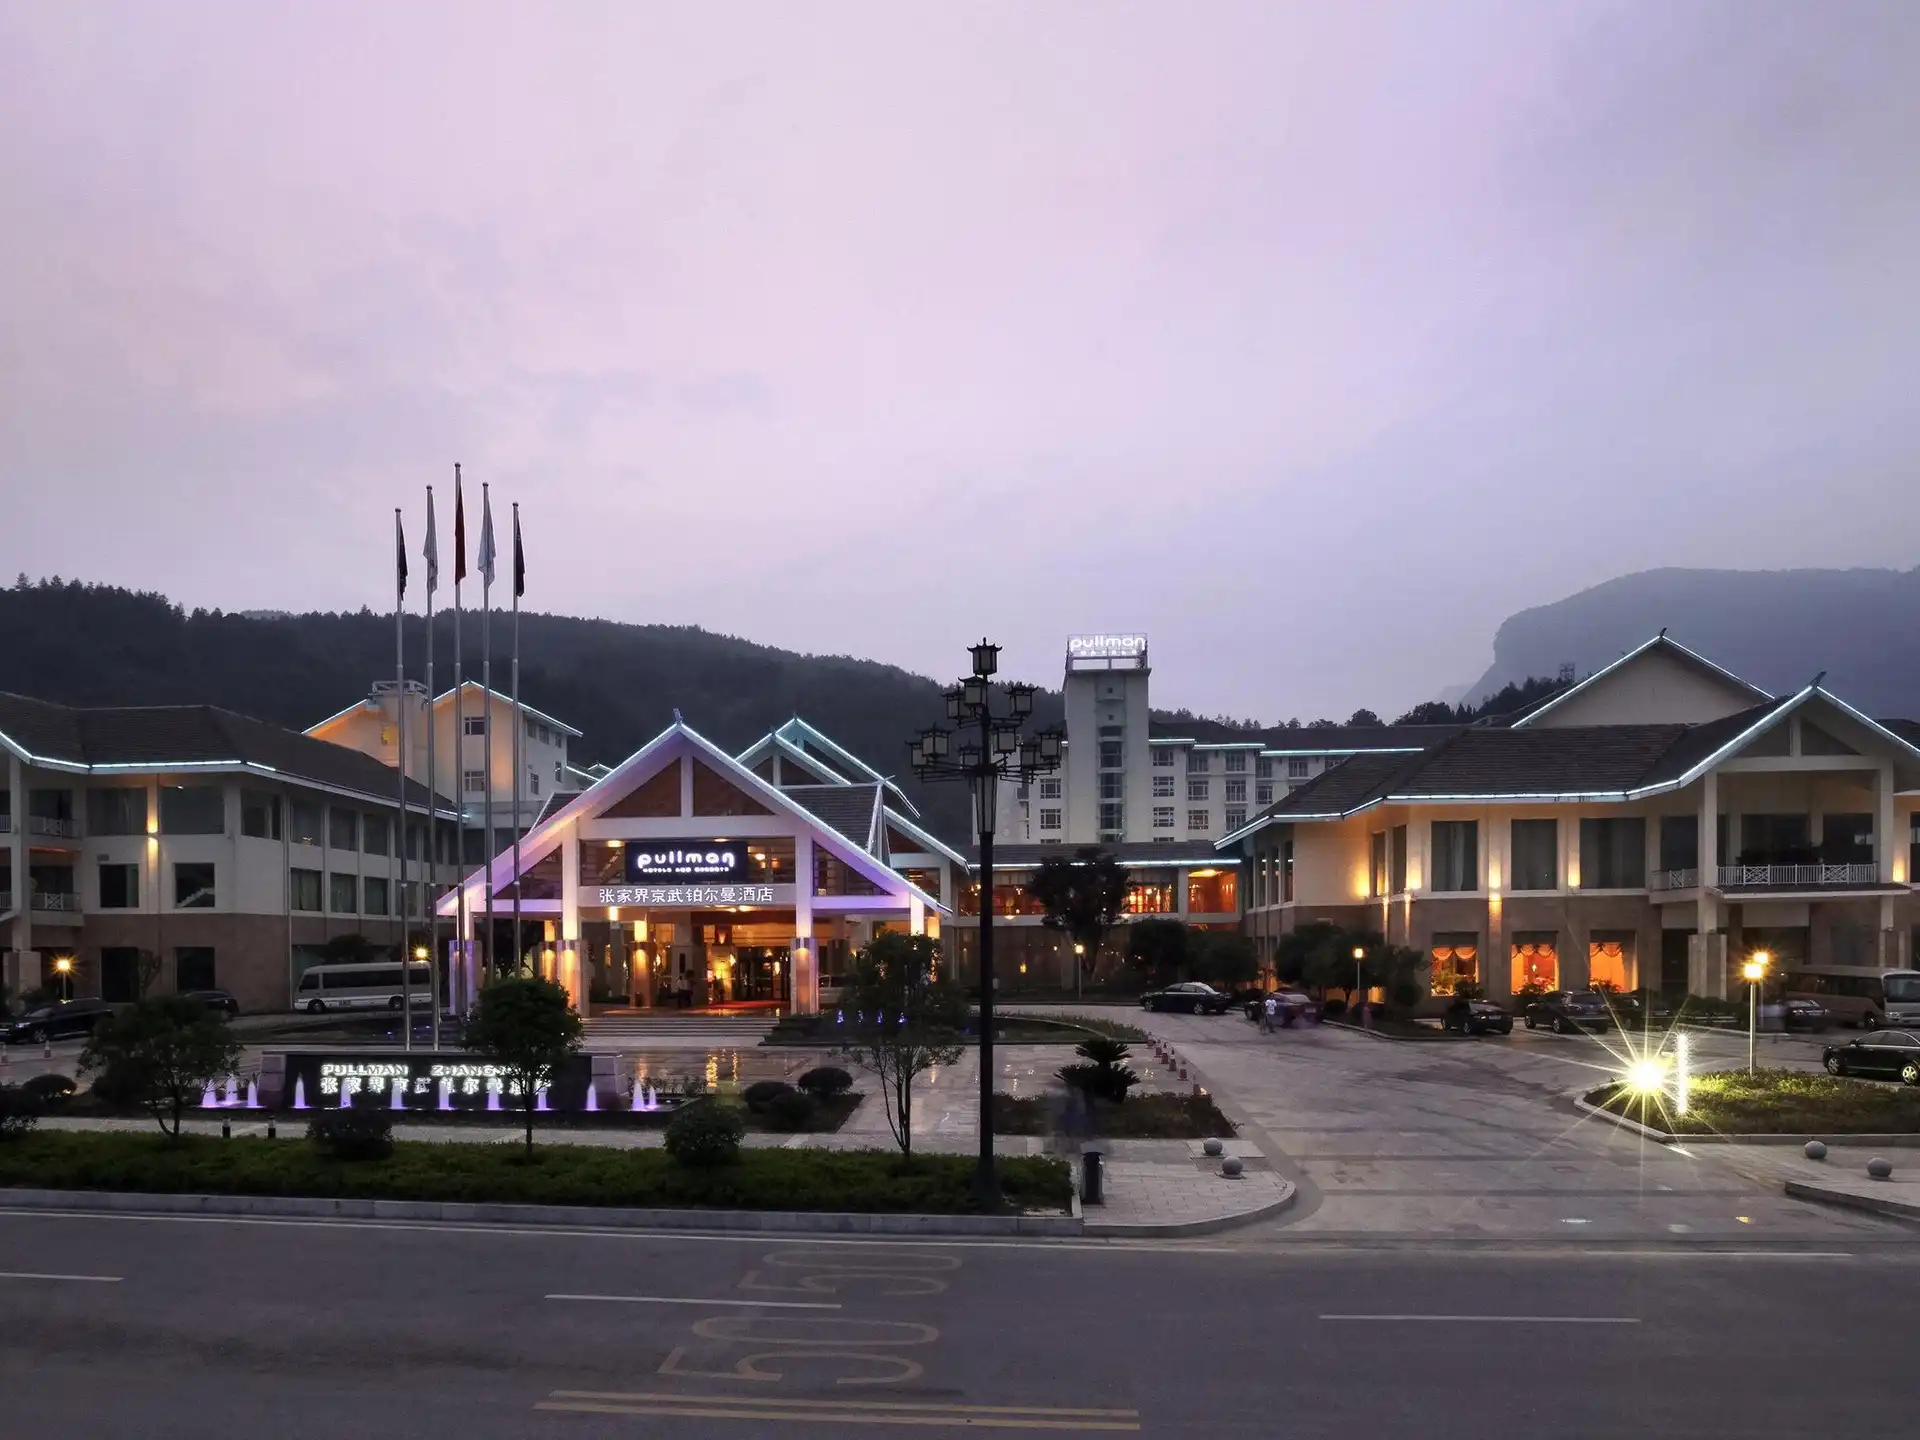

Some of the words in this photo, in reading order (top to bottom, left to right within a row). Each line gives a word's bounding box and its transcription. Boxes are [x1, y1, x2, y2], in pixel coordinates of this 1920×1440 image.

[1070, 635, 1146, 652] pullman
[637, 850, 735, 869] pullman
[599, 887, 774, 903] 张家界京武铂尔曼酒店
[320, 1063, 409, 1076] PULLMAN
